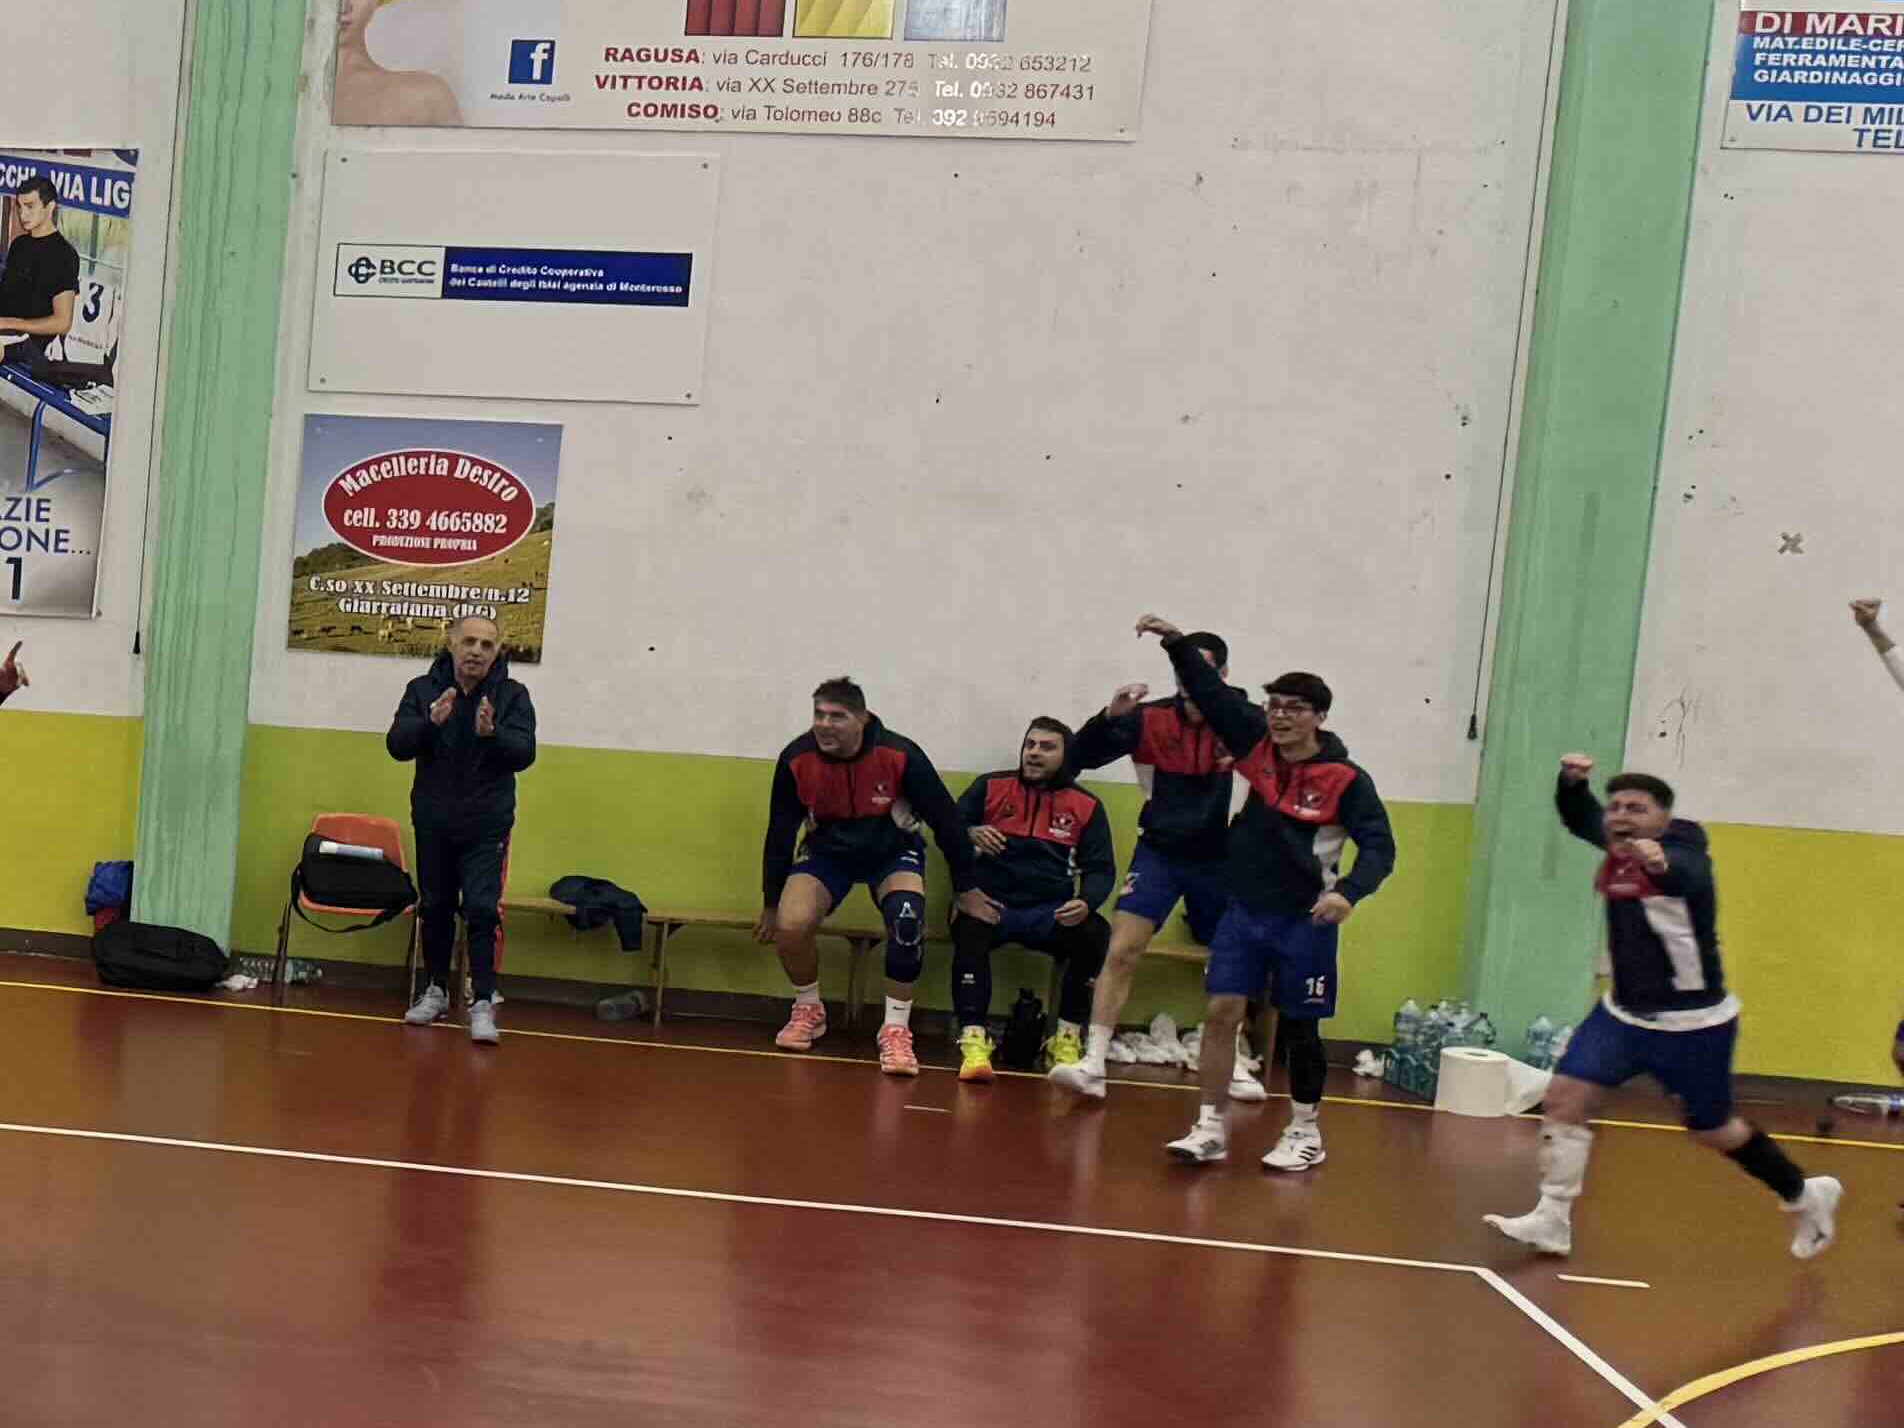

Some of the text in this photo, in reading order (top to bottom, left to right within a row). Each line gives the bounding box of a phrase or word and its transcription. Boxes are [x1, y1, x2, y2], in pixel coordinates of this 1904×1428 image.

[1754, 12, 1791, 34] DI
[604, 47, 705, 64] RAGUSA:
[713, 53, 738, 65] via
[745, 49, 827, 67] Carducci
[840, 52, 914, 69] 176/178
[1020, 55, 1091, 72] 653212
[594, 74, 1094, 100] VITTORIA: via XX Settembre Tel. 867431
[1753, 69, 1904, 85] GIARDINAGGI
[730, 107, 759, 121] via
[764, 105, 842, 123] Tolomeo
[847, 107, 882, 123] 88c
[1746, 103, 1793, 122] VIA
[1803, 105, 1852, 124] DEI
[379, 258, 437, 277] BCC
[82, 282, 104, 323] 3
[338, 454, 519, 503] Macelleria Destro
[343, 507, 508, 534] cell. 339 4665882
[309, 576, 347, 592] C.so
[382, 581, 480, 600] Settembre
[338, 597, 447, 618] Giarratana
